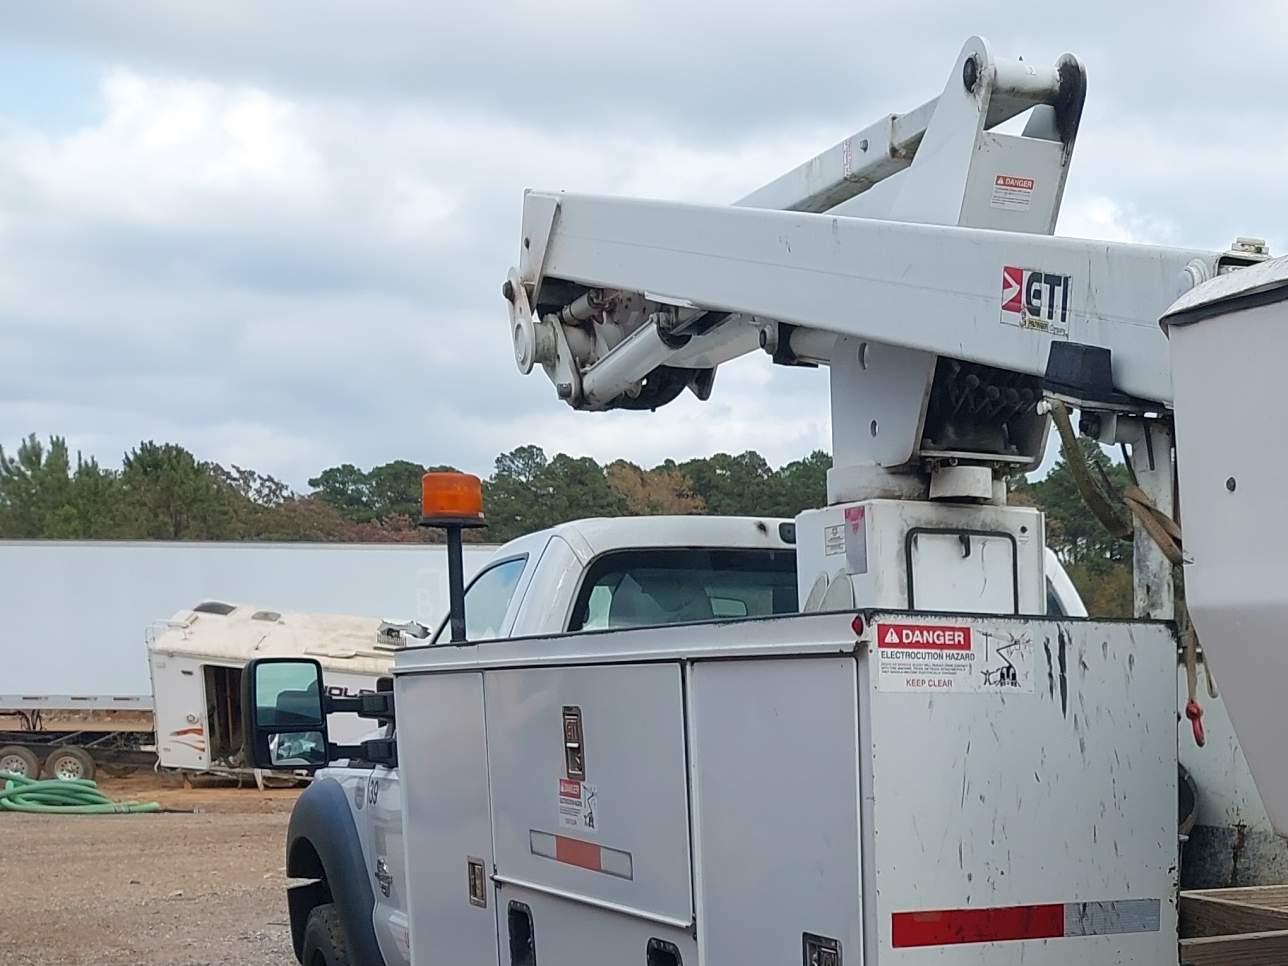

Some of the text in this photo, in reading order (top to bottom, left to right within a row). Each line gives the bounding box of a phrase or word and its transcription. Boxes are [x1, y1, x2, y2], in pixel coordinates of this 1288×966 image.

[1005, 178, 1032, 188] DANGER
[1025, 272, 1069, 323] ETI
[902, 630, 965, 645] DANGER
[881, 651, 975, 661] ELECTROCUTION HAZARD
[906, 679, 953, 688] KEEP CLEAR
